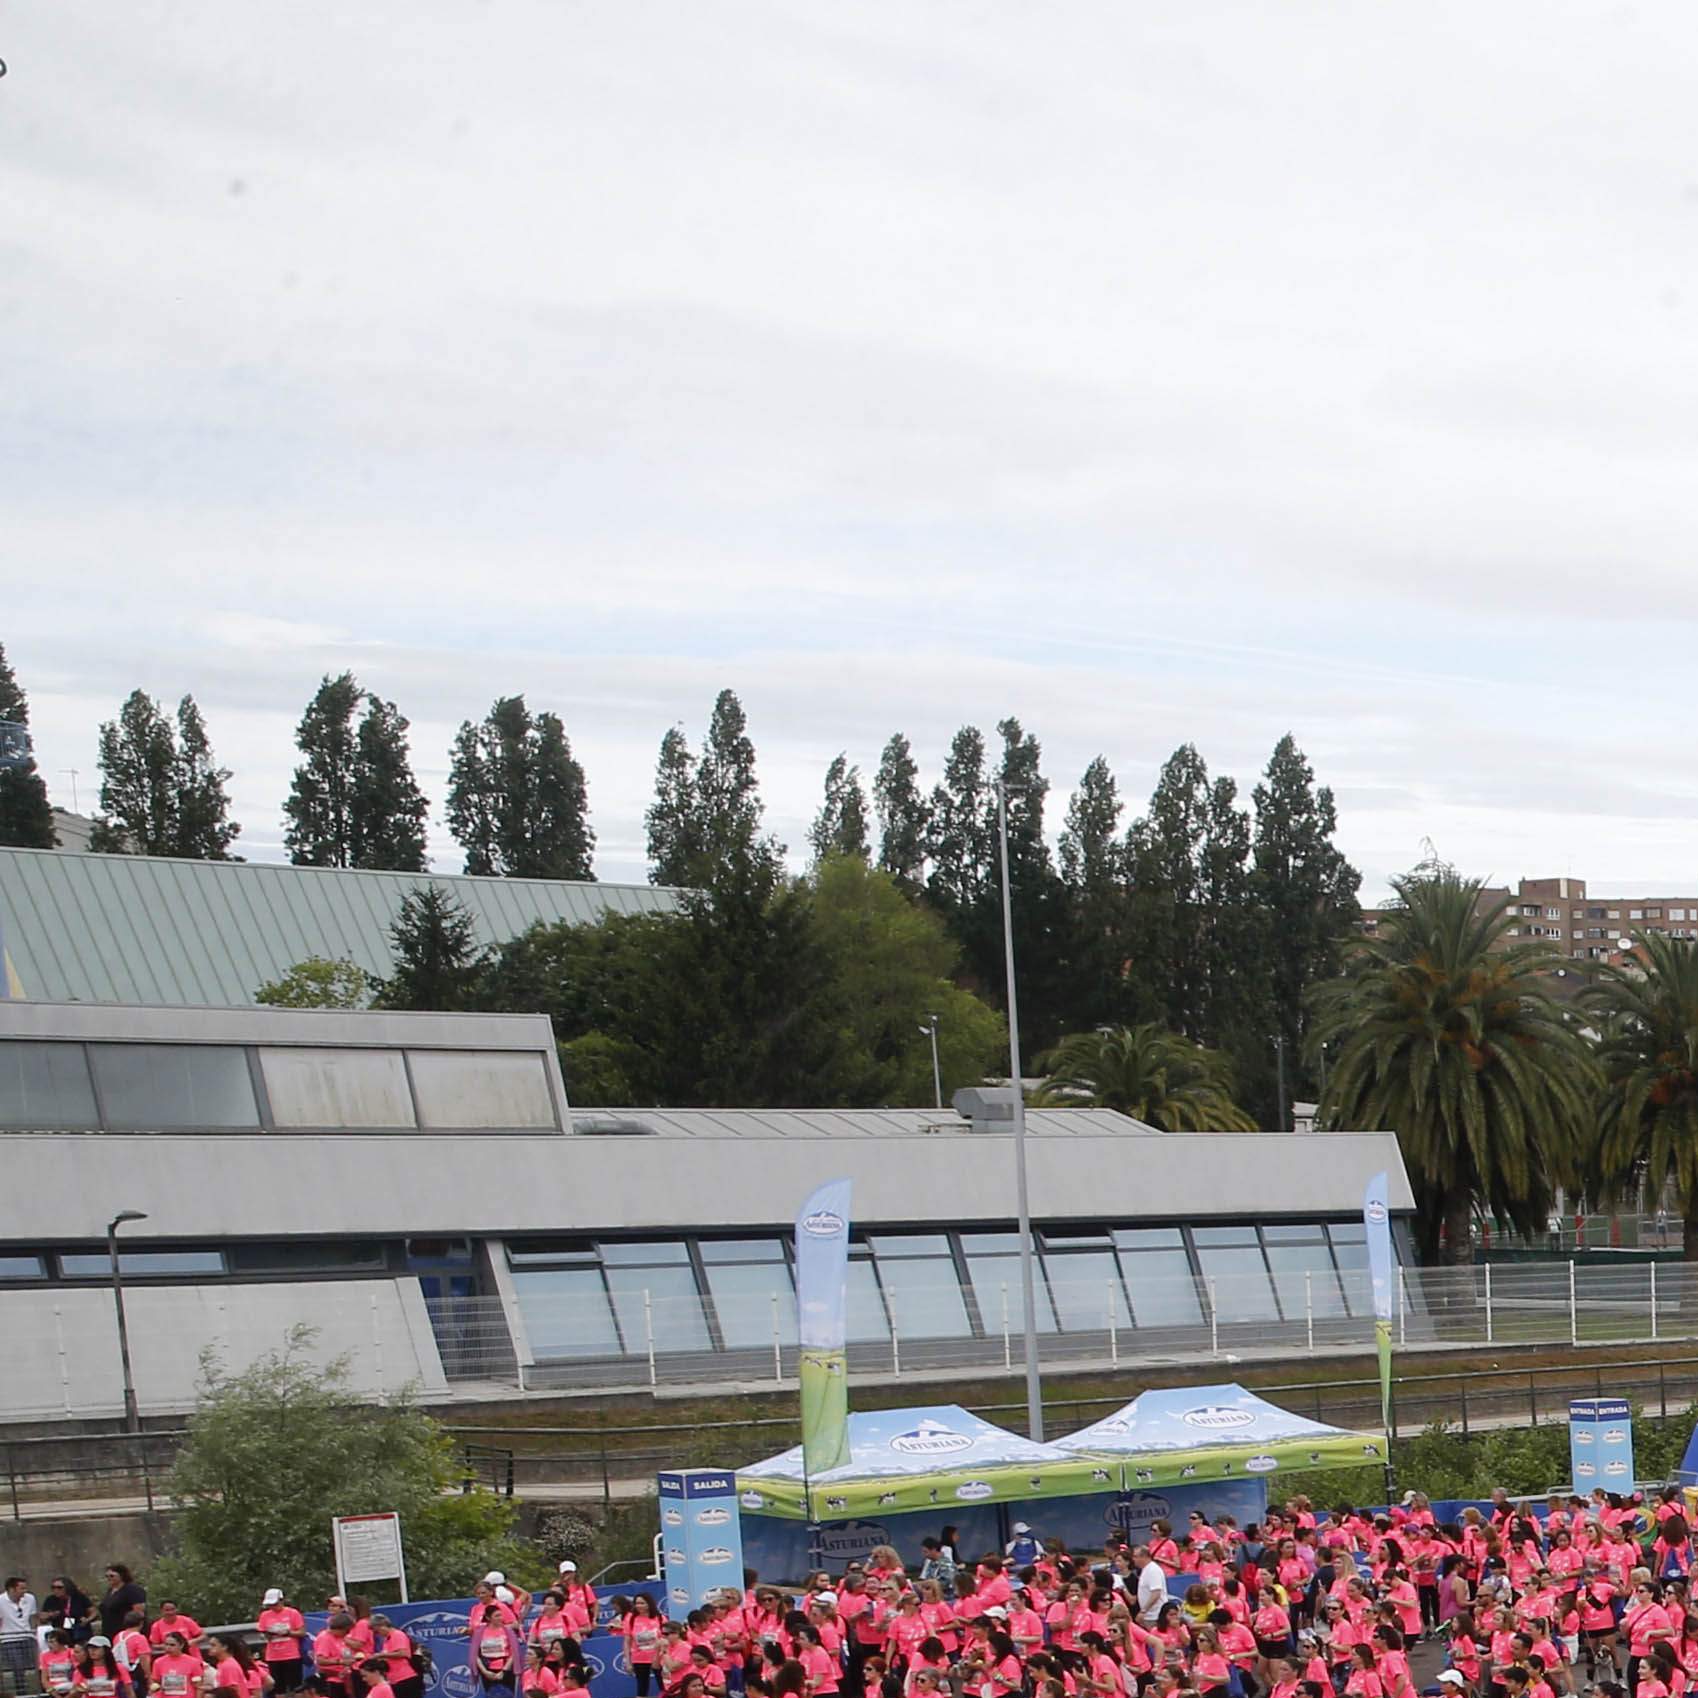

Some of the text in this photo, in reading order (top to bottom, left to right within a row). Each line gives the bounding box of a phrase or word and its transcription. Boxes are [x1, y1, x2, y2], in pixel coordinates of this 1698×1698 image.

[1599, 1404, 1627, 1415] ENTRADA
[1194, 1411, 1250, 1425] ASTURIANA
[899, 1437, 967, 1452] ASTURIANA
[694, 1479, 728, 1491] SALIDA
[821, 1534, 885, 1551] ASTURIANA
